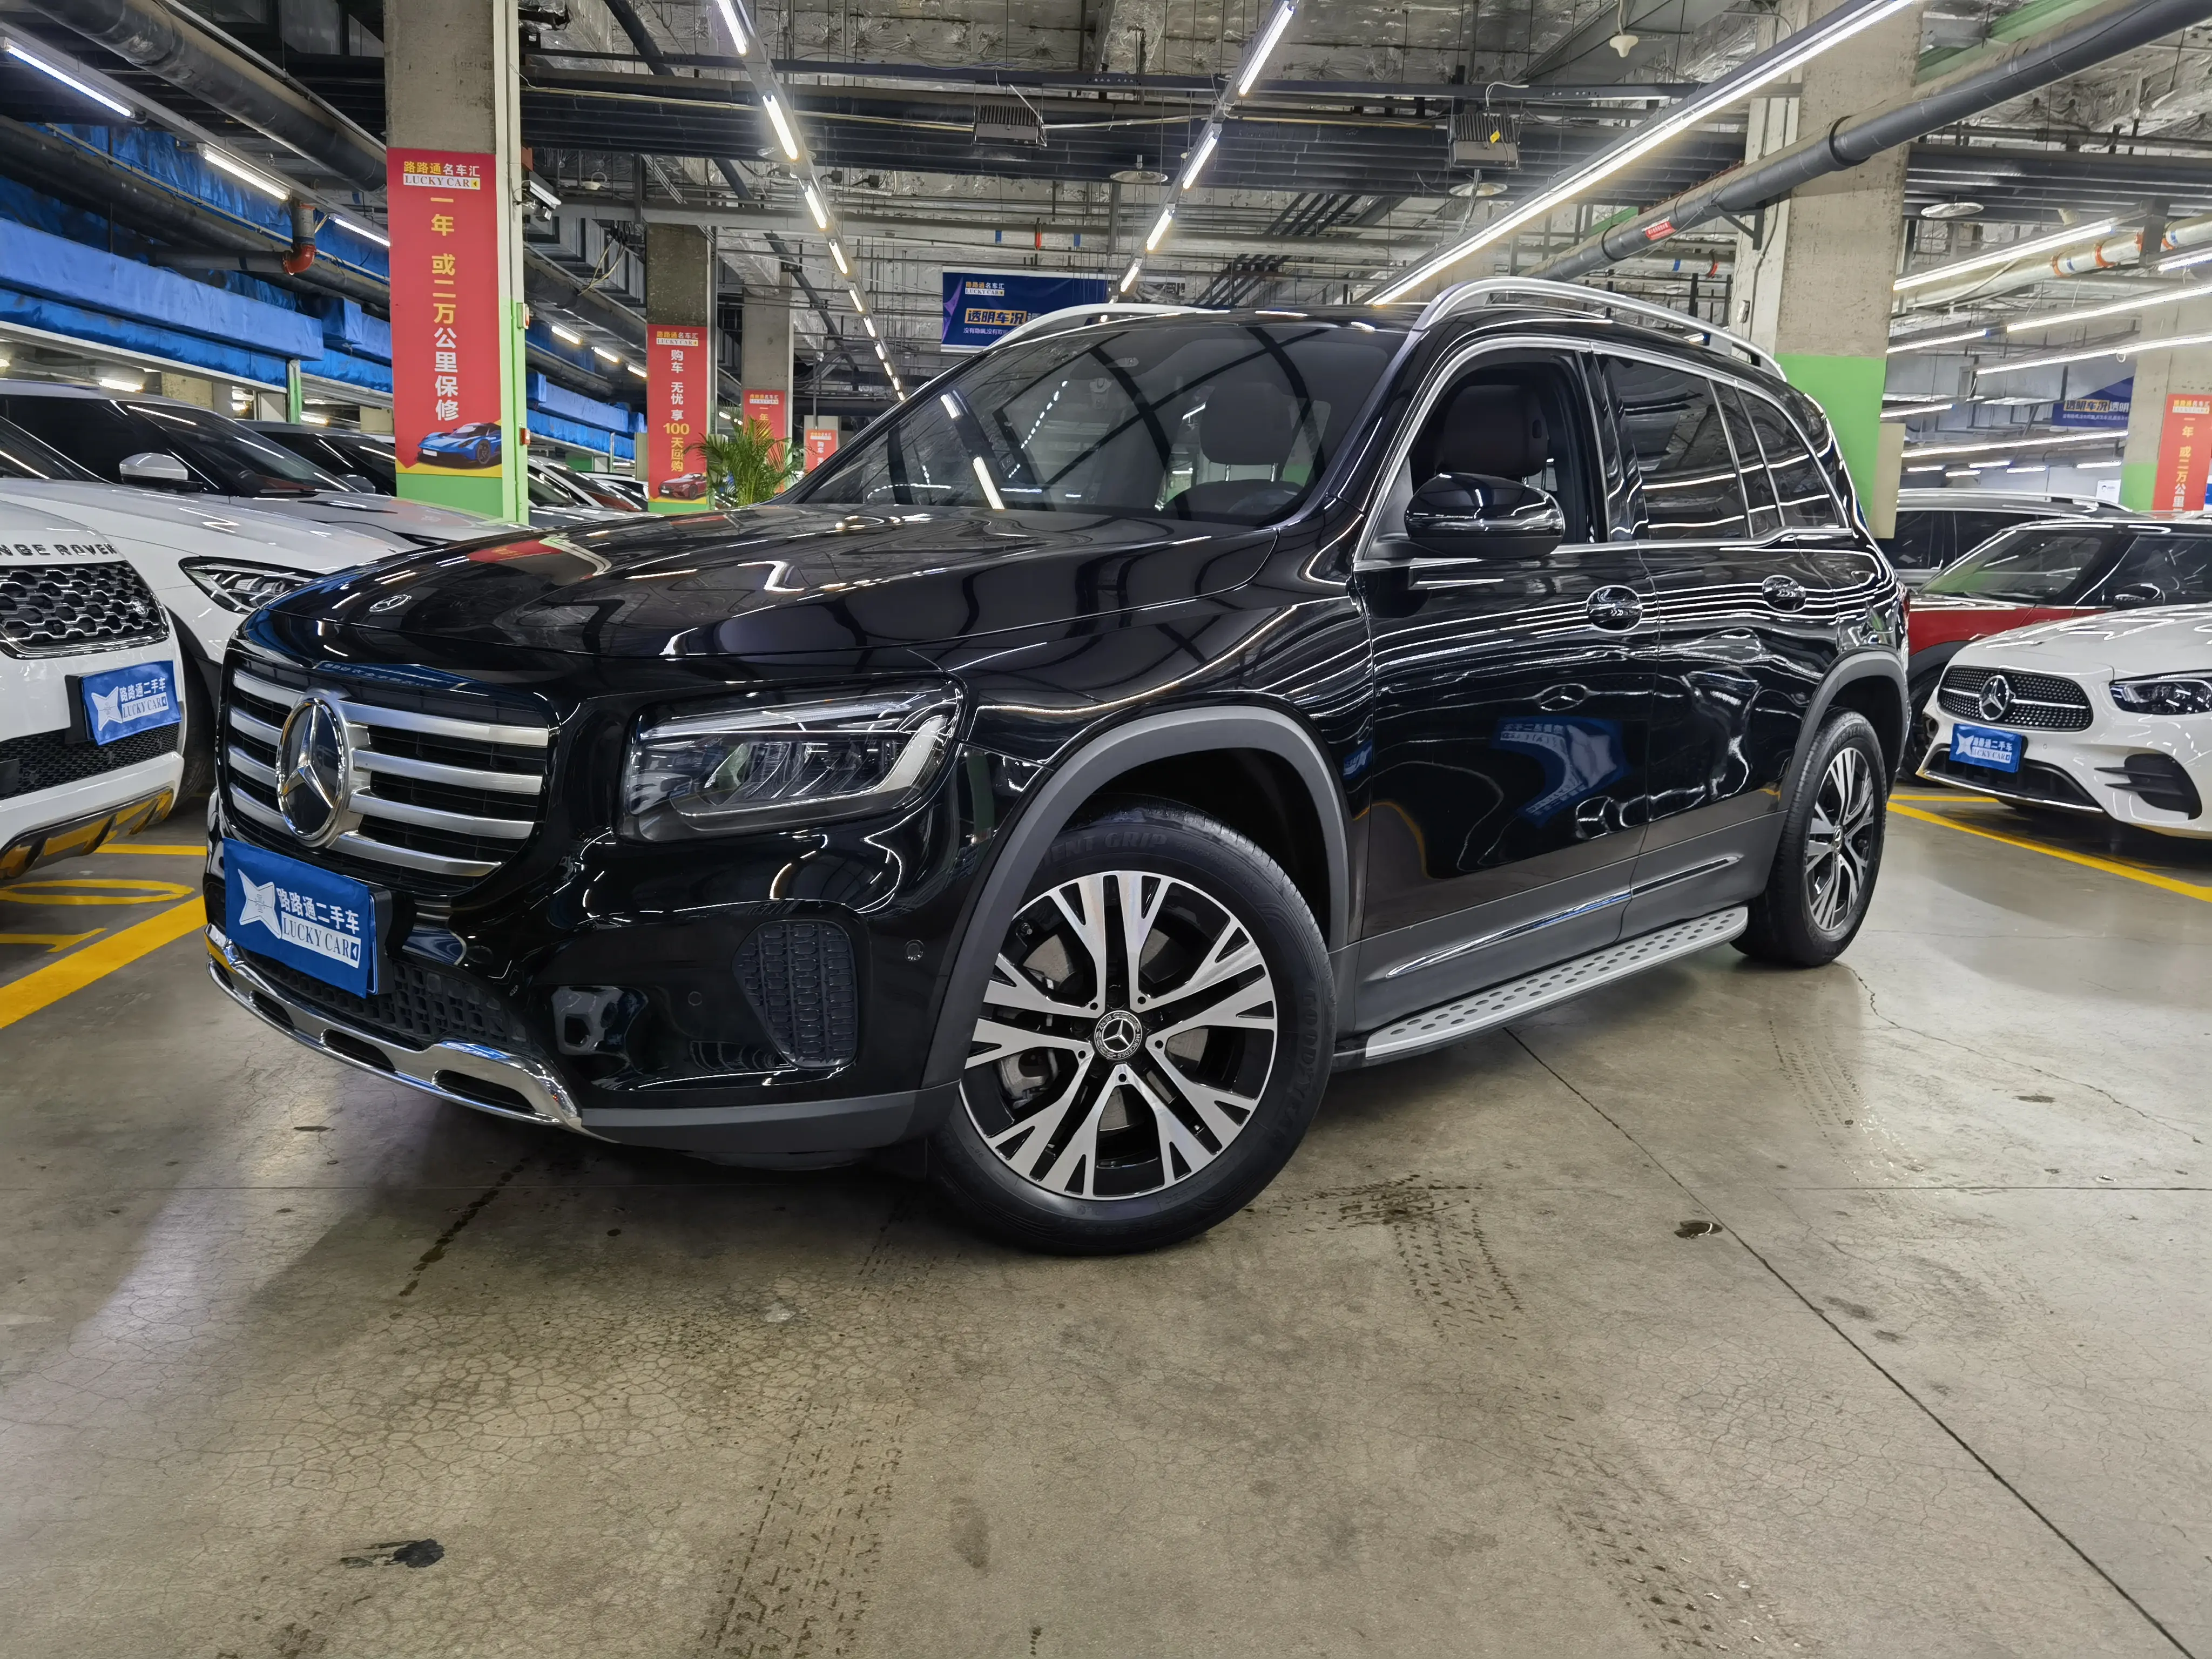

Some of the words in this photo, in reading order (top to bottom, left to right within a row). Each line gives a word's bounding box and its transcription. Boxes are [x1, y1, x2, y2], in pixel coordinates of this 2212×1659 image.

[403, 161, 480, 177] 路路通名车汇
[405, 176, 443, 186] LUCKY
[447, 178, 469, 187] CAR
[431, 253, 458, 421] 或二万公里保修
[53, 543, 118, 556] ROVER
[119, 677, 166, 702] 路路通二手车
[123, 701, 145, 718] LUCKY
[147, 697, 161, 711] CAR
[1992, 751, 2006, 760] CAR
[276, 887, 360, 934] 路路通二手车
[284, 917, 321, 947] LUCKY
[325, 933, 350, 960] CAR
[1098, 1015, 1112, 1030] BENZ
[1117, 1033, 1141, 1058] MERCEDES
